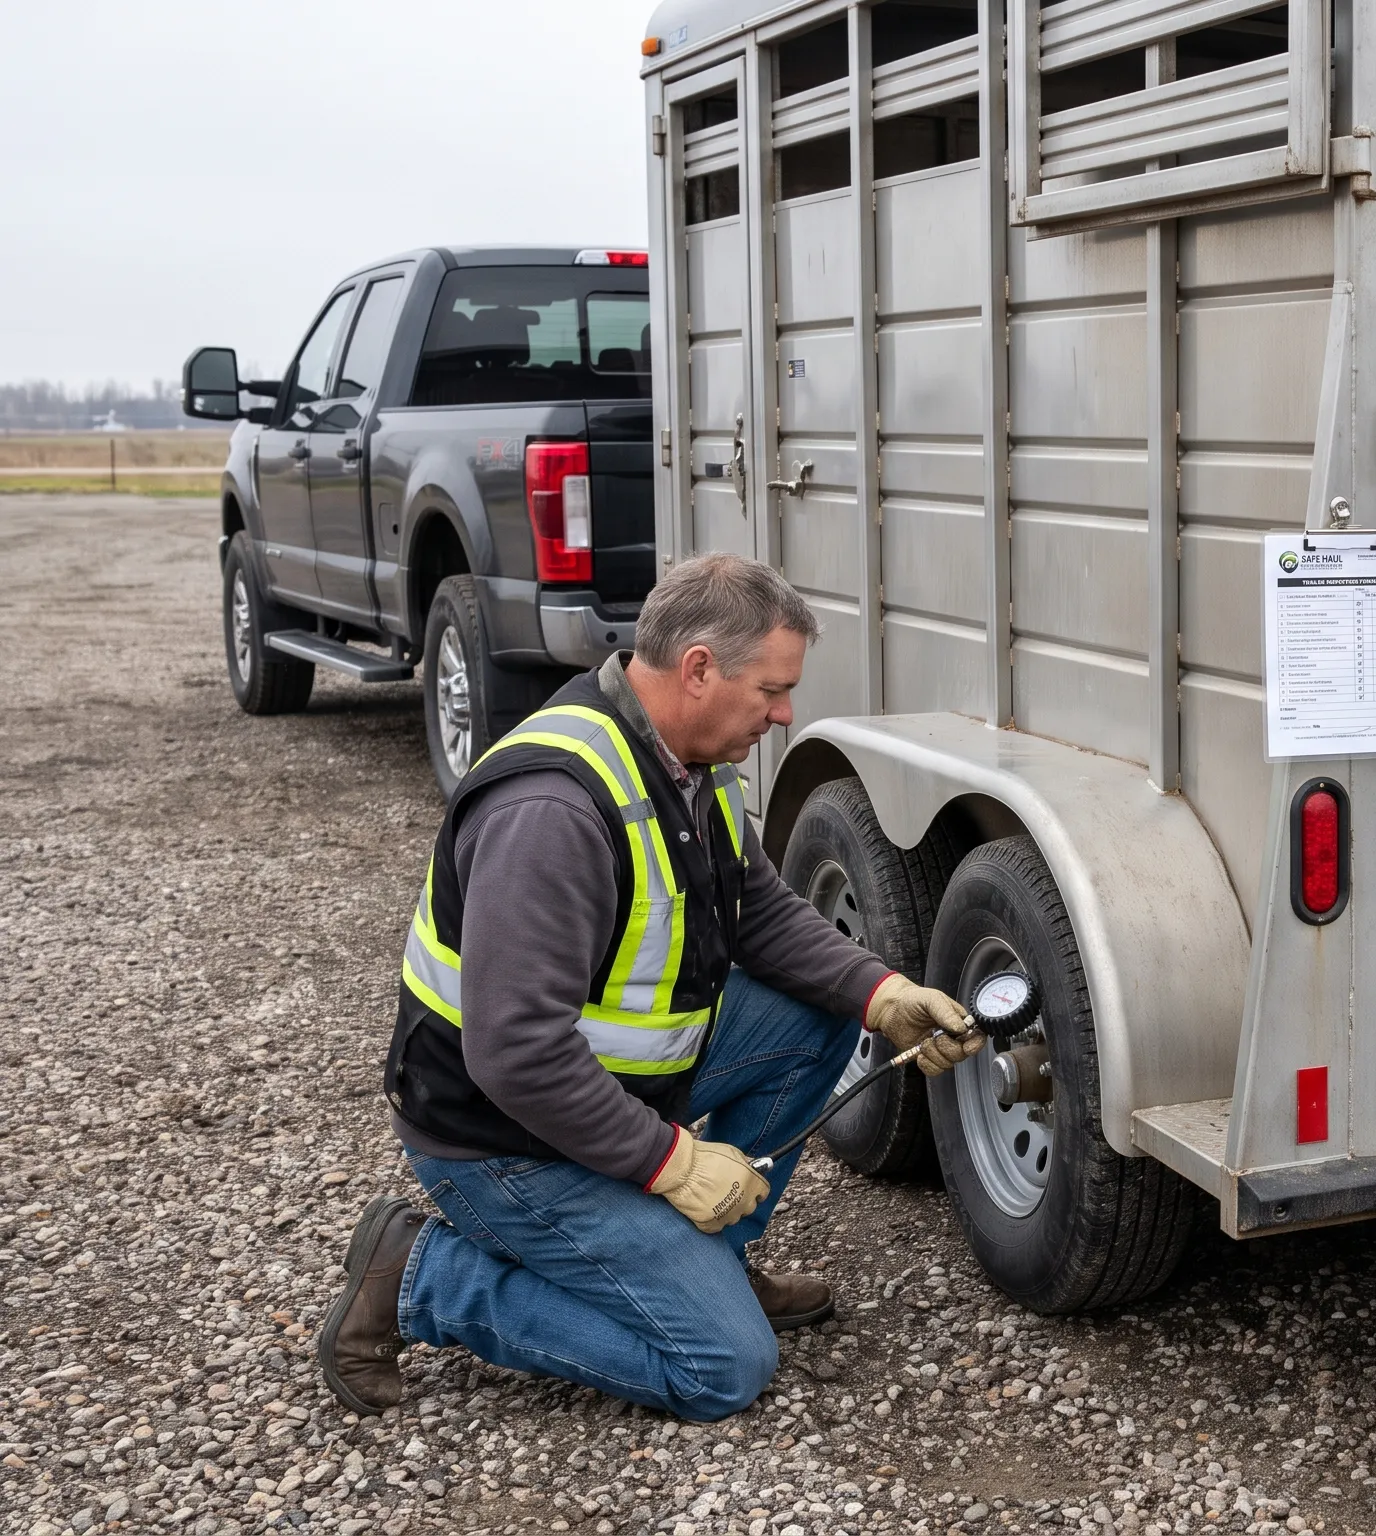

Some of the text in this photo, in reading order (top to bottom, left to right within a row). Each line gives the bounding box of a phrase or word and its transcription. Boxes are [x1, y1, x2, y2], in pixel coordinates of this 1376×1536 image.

[476, 437, 523, 465] FX4
[1301, 555, 1343, 563] SAFE HAUL
